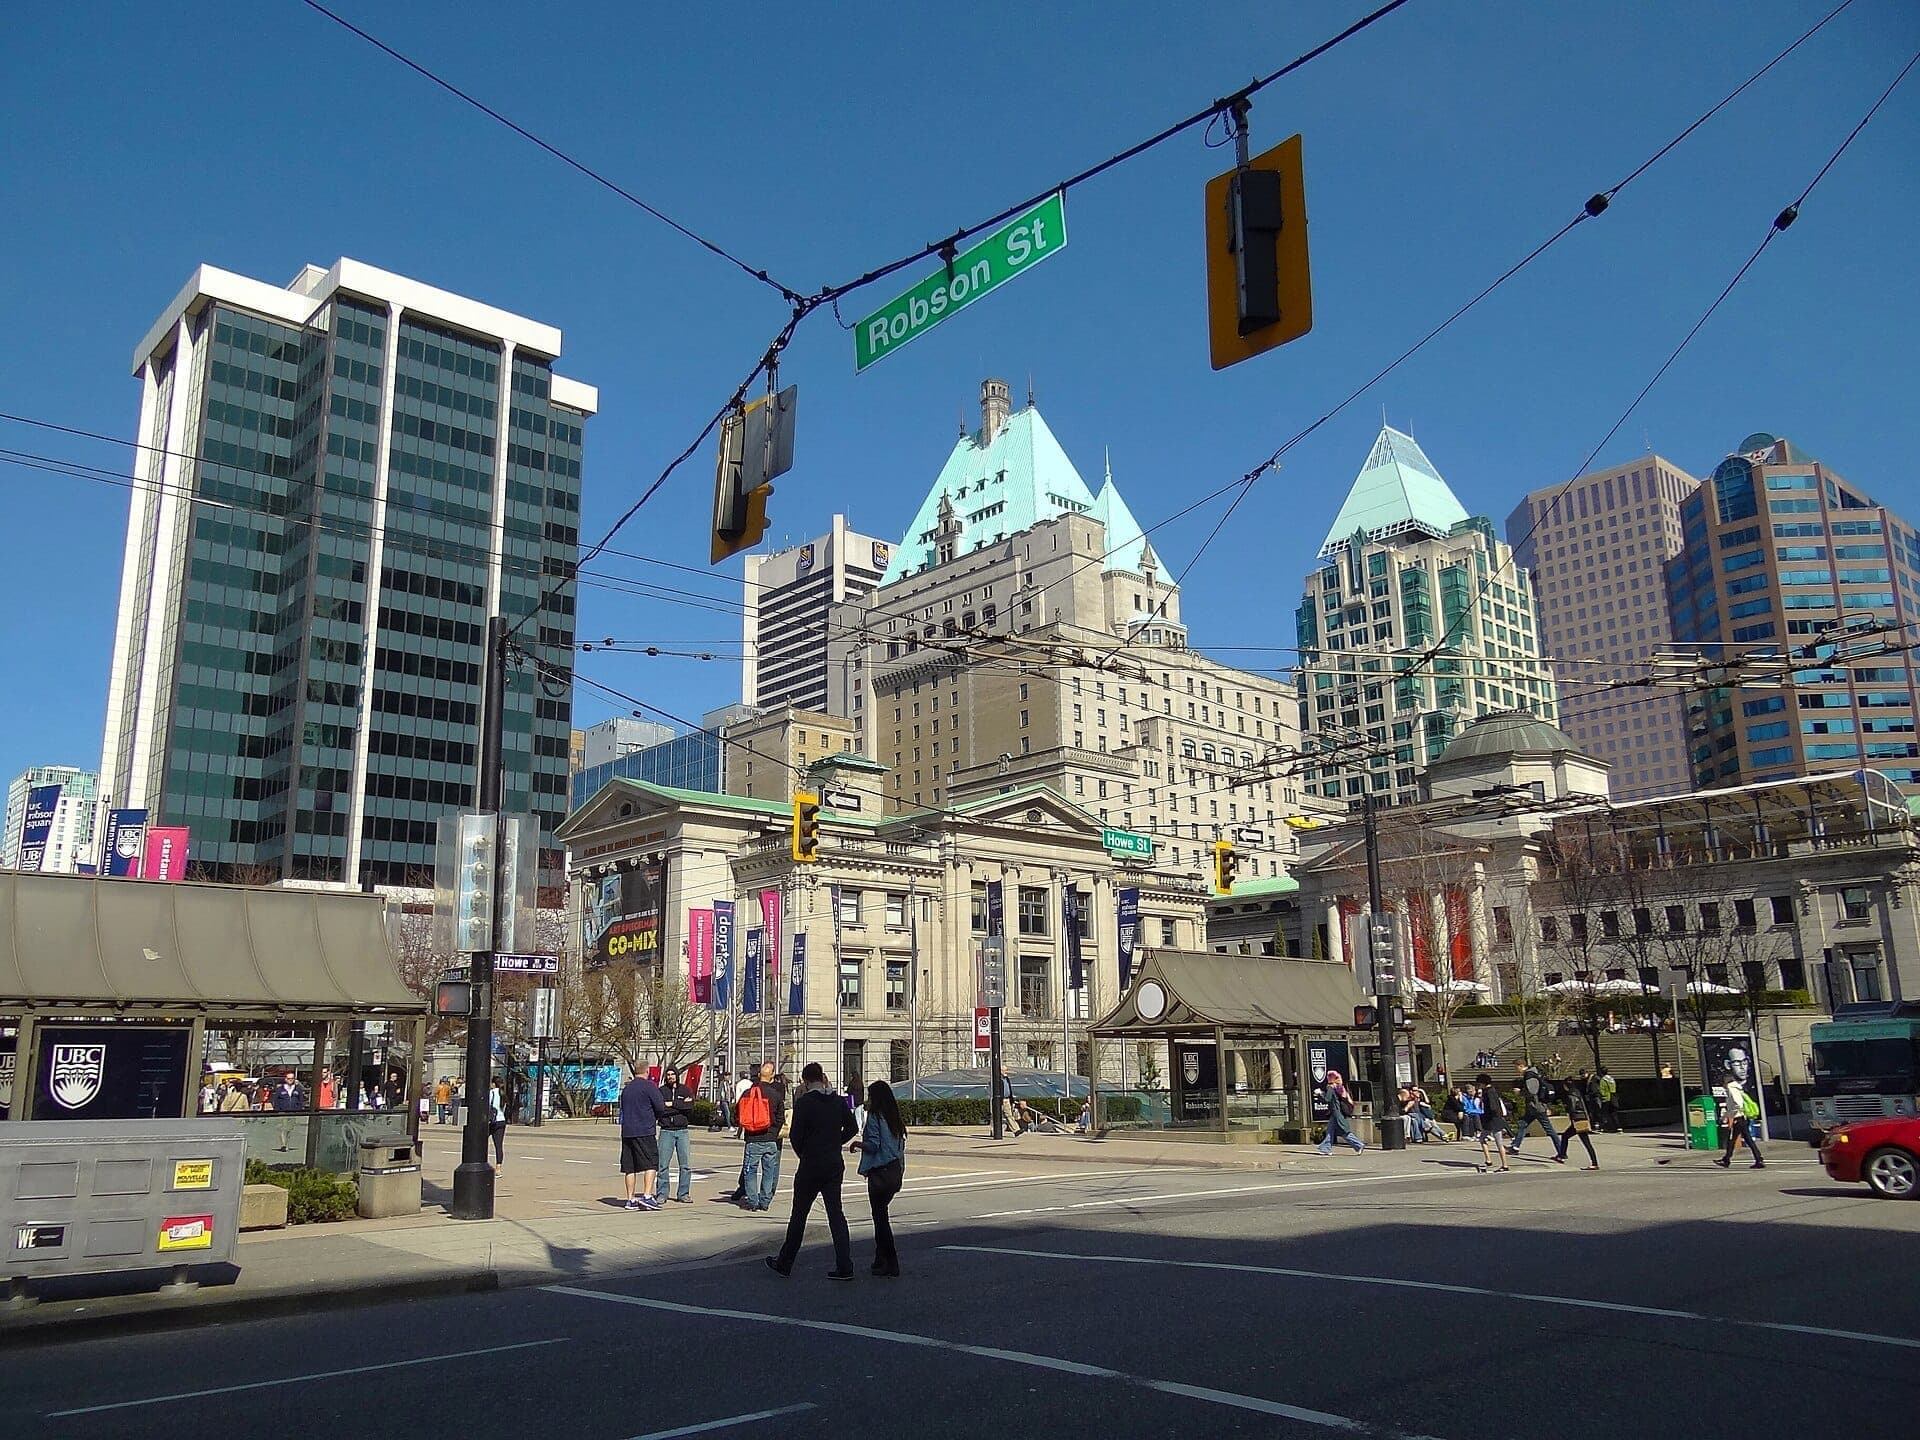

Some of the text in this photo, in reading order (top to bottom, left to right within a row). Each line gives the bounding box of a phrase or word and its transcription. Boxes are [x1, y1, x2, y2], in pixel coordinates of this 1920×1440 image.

[868, 217, 1047, 354] Robson St
[26, 820, 52, 830] squar
[107, 813, 118, 851] COLUMBIA
[1107, 833, 1148, 852] Howe St
[608, 930, 658, 956] CO-MIX
[501, 957, 528, 968] Howe
[57, 1048, 101, 1064] UBC
[18, 1229, 37, 1249] WE
